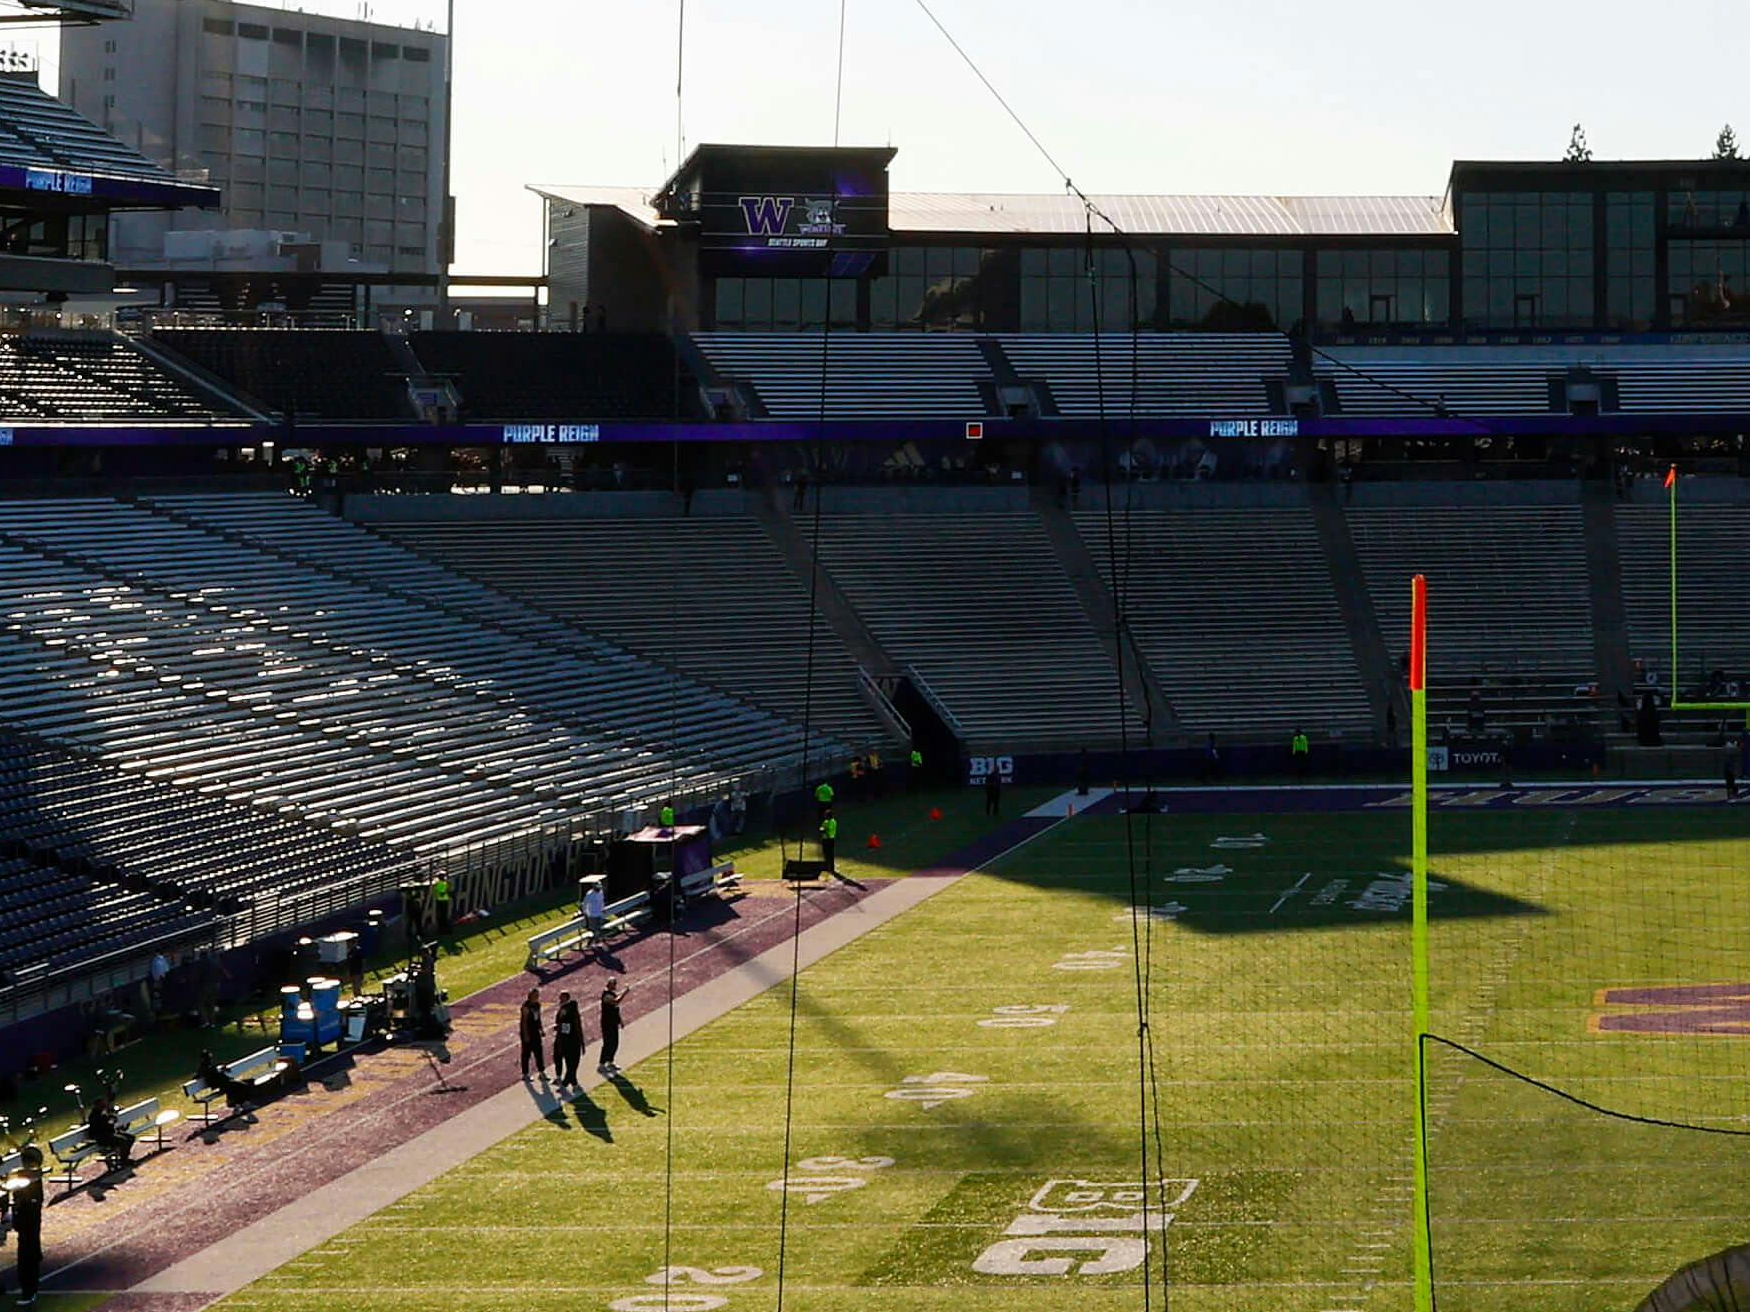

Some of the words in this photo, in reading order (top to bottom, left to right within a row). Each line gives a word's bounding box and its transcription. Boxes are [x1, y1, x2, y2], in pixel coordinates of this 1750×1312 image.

[26, 170, 62, 191] PURPLE
[738, 196, 794, 236] W
[503, 424, 556, 443] PURPLE
[559, 424, 599, 443] REIGN
[1210, 420, 1259, 437] PURPLE
[1261, 419, 1299, 437] REIGN
[1452, 751, 1501, 764] TOYOT
[976, 1004, 1072, 1029] 50
[883, 1071, 991, 1101] 40
[766, 1155, 896, 1193] 30
